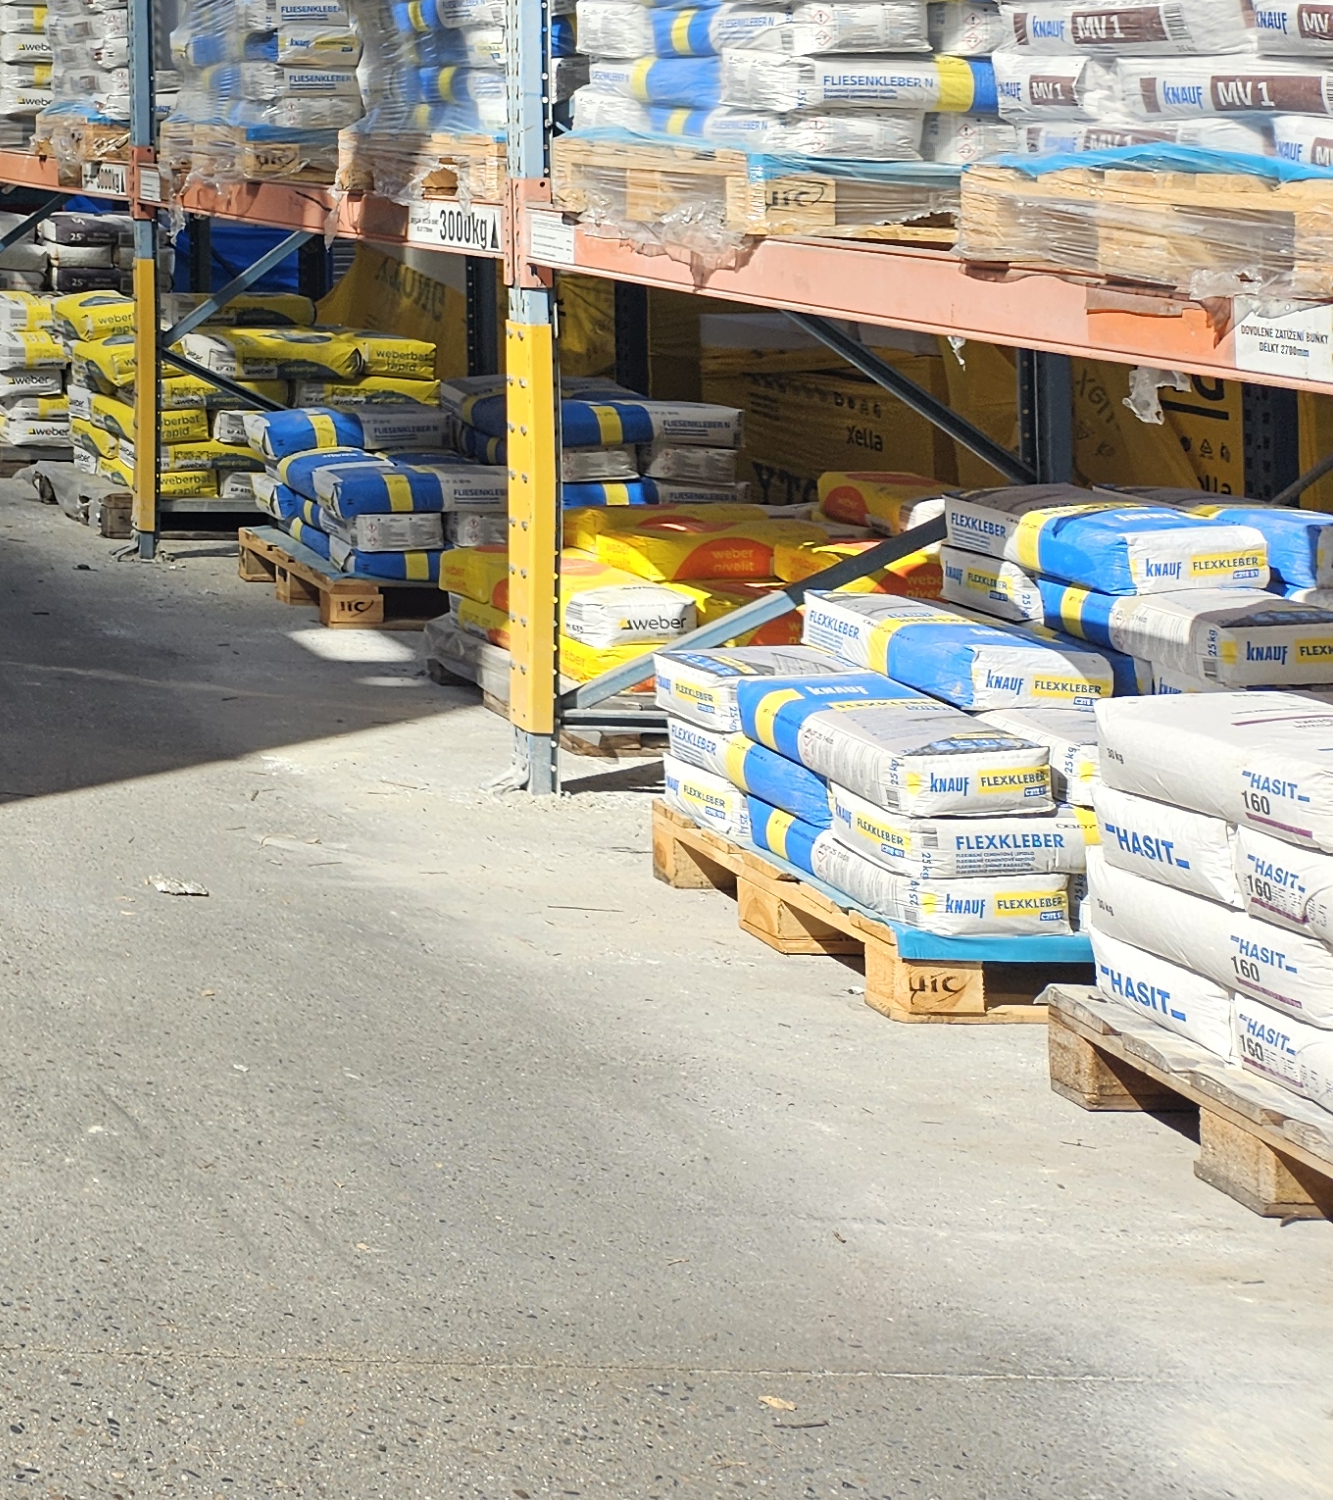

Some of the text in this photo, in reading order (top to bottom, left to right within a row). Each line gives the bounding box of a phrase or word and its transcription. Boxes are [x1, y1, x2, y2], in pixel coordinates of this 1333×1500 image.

[1033, 15, 1125, 39] KNAUF MV 1
[823, 75, 933, 88] FLIESENKLEBER N
[1163, 80, 1275, 109] KNAUF MV 1
[71, 233, 81, 241] 25
[15, 375, 49, 385] weber
[846, 426, 883, 451] Xella
[951, 512, 1006, 538] FLEXKLEBER
[712, 548, 754, 560] weber
[713, 560, 754, 572] nivelit
[945, 560, 1008, 590] KNAUF FLEXKLEBER
[1145, 556, 1259, 579] KNAUF FLEXKLEBER
[633, 615, 687, 631] weber
[810, 610, 860, 640] FLEXKLEBER
[1247, 641, 1287, 665] KNAUF
[675, 683, 714, 702] FLEXKLEBER
[985, 670, 1101, 695] KNAUF FLEXKLEBER
[671, 724, 717, 755] FLEXKLEBER
[930, 770, 1045, 796] KNAUF FLEXKLEBER
[1251, 774, 1297, 799] HASIT
[683, 785, 726, 808] FLEXKLEBER
[1241, 790, 1270, 815] 160
[856, 818, 904, 846] FLEXKLEBER
[956, 834, 1065, 850] FLEXKLEBER
[1116, 828, 1174, 866] HASIT
[1255, 858, 1299, 889] HASIT
[1247, 873, 1272, 901] 160
[945, 894, 1062, 918] KNAUF FLEXKLEBER
[1239, 937, 1286, 969] HASIT
[1232, 956, 1260, 984] 160
[1111, 966, 1171, 1014] HASIT
[1246, 1016, 1290, 1052] HASIT
[1239, 1033, 1264, 1062] 160
